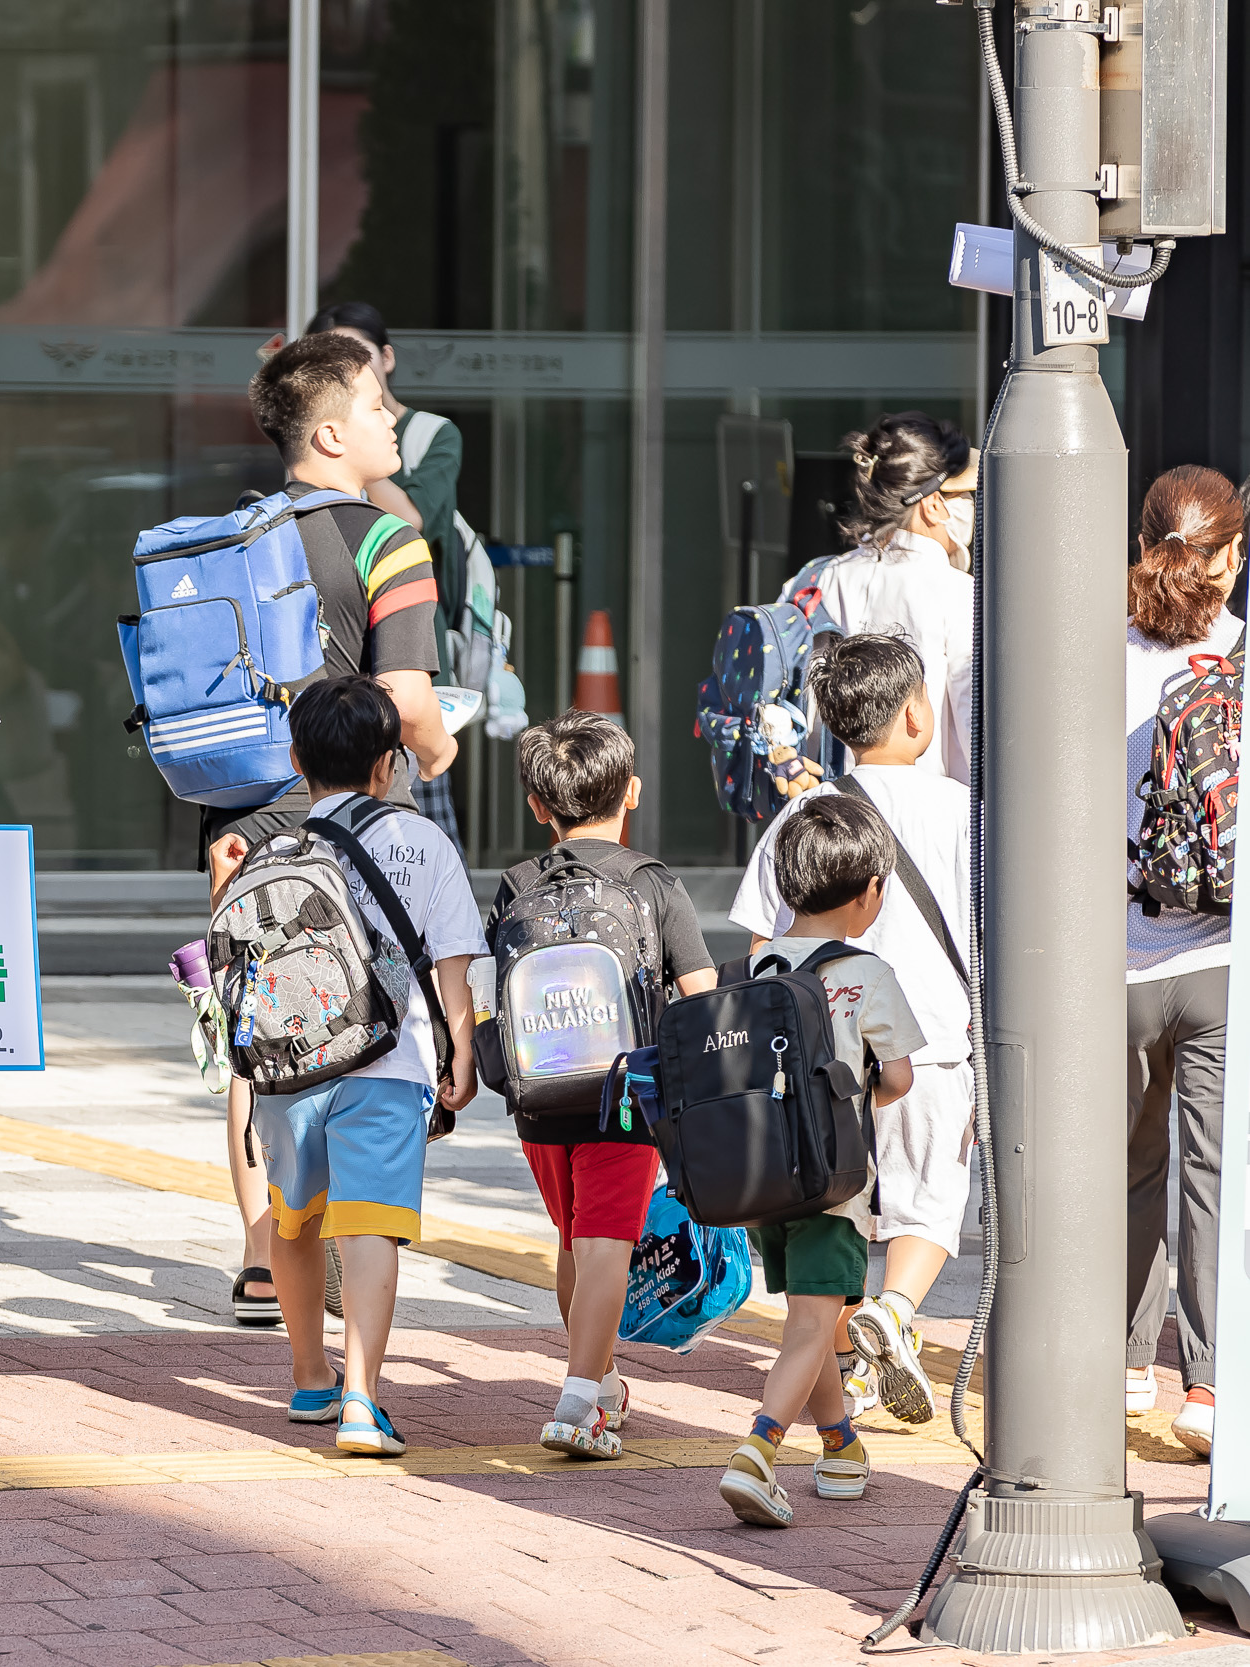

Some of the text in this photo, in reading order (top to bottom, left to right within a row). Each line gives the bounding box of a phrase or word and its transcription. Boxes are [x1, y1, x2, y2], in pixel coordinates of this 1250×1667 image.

[1053, 299, 1098, 334] 10-8
[171, 587, 198, 599] adidas
[387, 844, 426, 867] 1624
[545, 986, 590, 1011] NEW
[523, 1002, 620, 1034] BALANCE
[628, 1263, 676, 1305] Ocean Kids
[637, 1282, 670, 1311] 458-3008
